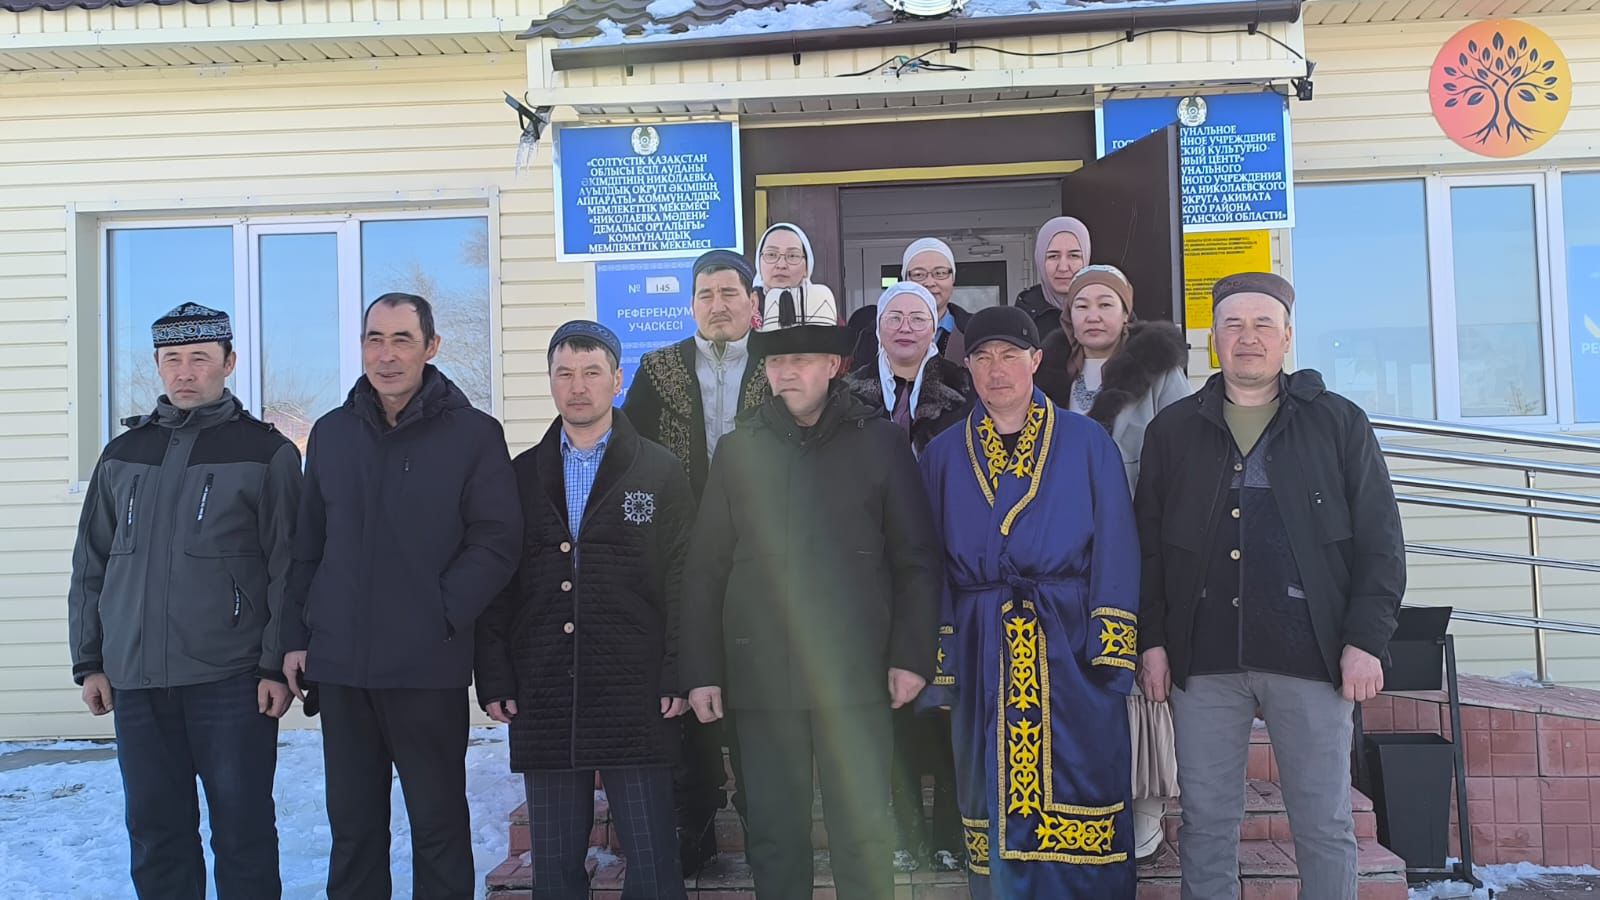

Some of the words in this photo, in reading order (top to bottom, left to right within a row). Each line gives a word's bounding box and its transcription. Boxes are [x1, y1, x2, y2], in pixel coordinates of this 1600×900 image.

[1181, 136, 1208, 146] ННОЕ
[1209, 133, 1277, 145] УЧРЕЖДЕНИЕ
[648, 154, 708, 166] ҚАЗАҚСТАН
[591, 166, 634, 177] ОБЛЫСЫ
[637, 165, 659, 175] ЕСІЛ
[661, 164, 705, 175] АУДАНЫ
[1181, 164, 1242, 176] УНАЛЬНОГО
[647, 172, 715, 184] НИКОЛАЕВКА
[1182, 175, 1212, 185] НОГО
[1213, 172, 1282, 185] УЧРЕЖДЕНИЯ
[579, 185, 631, 197] АУЫЛДЫҚ
[632, 184, 667, 195] ОКРУГІ
[669, 181, 718, 192] ӘКІМІНІҢ
[1199, 182, 1286, 194] НИКОЛАЕВСКОГО
[638, 191, 721, 204] КОММУНАЛДЫҚ
[1221, 192, 1272, 203] АКИМАТА
[588, 203, 657, 215] МЕМЛЕКЕТТІК
[659, 201, 710, 212] МЕКЕМЕСІ
[1209, 202, 1251, 213] РАЙОНА
[593, 223, 643, 235] ДЕМАЛЫС
[608, 230, 692, 244] КОММУНАЛДЫҚ
[589, 241, 659, 253] МЕМЛЕКЕТТІК
[660, 239, 711, 251] МЕКЕМЕСІ
[617, 306, 693, 319] РЕФЕРЕНДУМ
[628, 320, 683, 332] УЧАСКЕСІ
